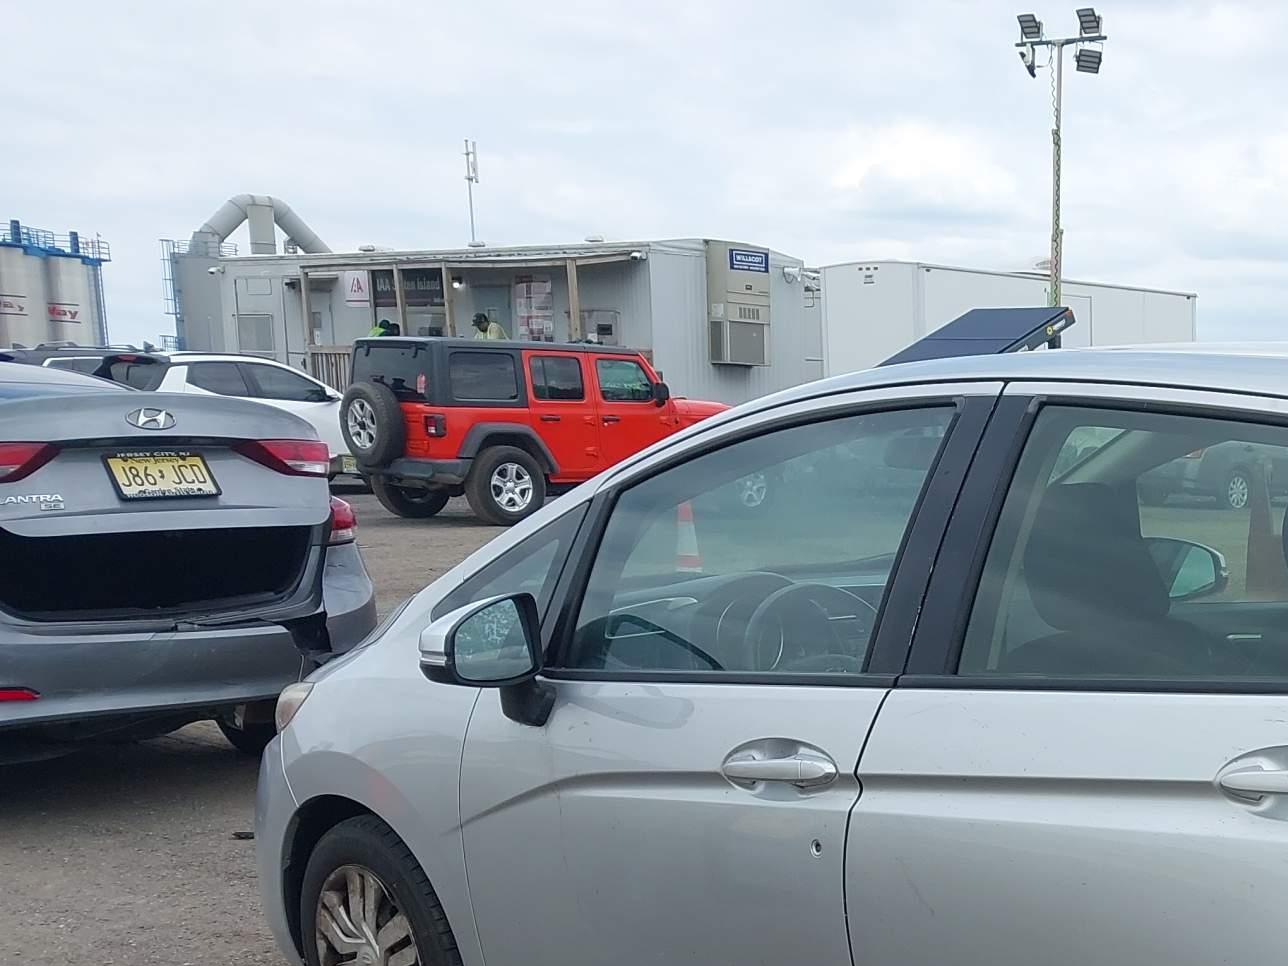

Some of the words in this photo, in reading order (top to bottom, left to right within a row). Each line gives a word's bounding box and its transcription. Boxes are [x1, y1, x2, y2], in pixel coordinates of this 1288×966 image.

[121, 465, 157, 488] J86
[171, 463, 207, 485] JCD
[0, 494, 64, 504] ANTRA
